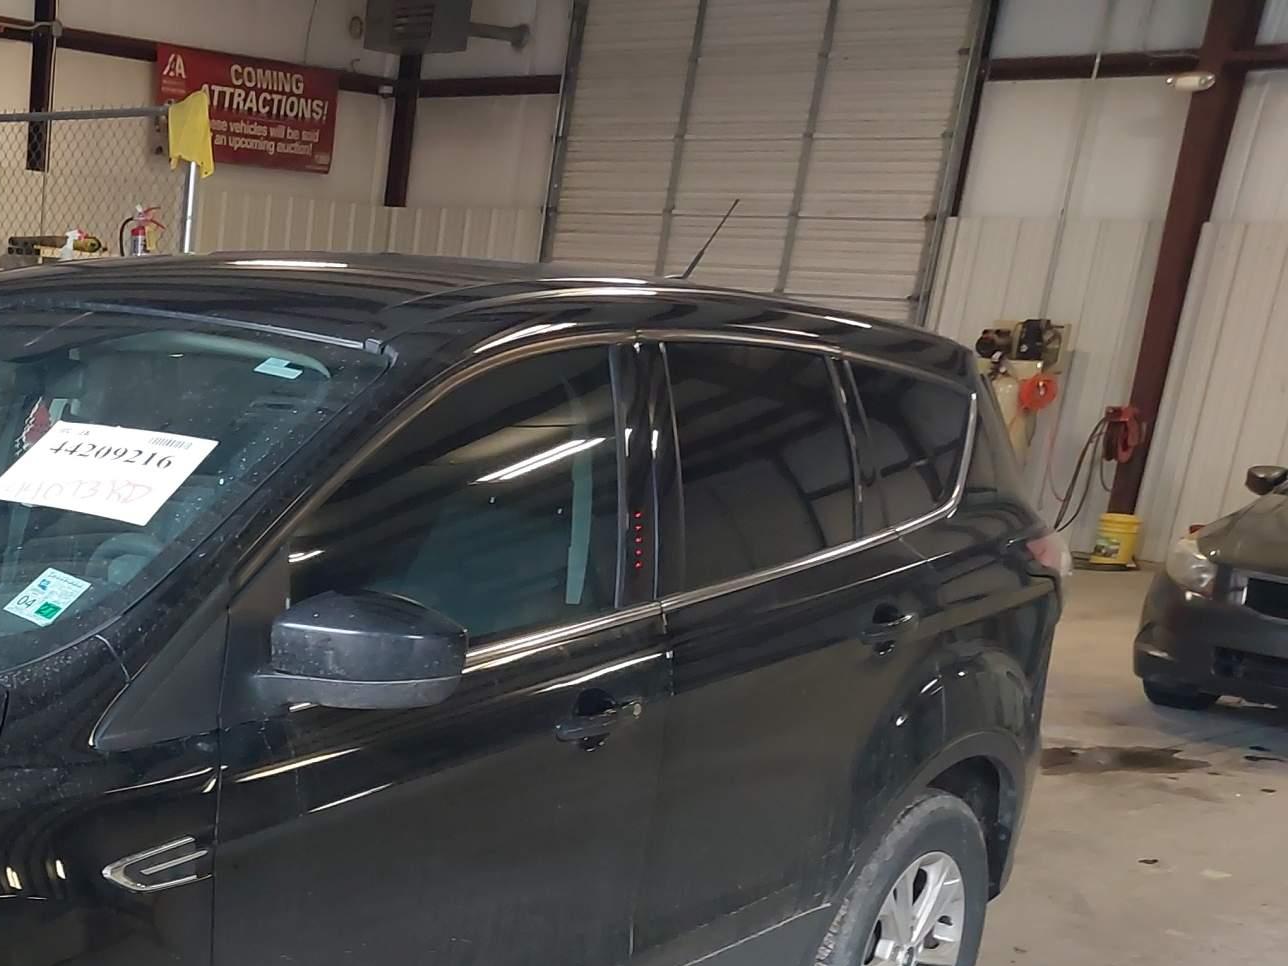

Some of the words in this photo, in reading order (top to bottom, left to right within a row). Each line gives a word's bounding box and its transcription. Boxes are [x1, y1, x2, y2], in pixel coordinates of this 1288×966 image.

[230, 64, 304, 94] COMING
[229, 120, 268, 136] vehicles
[269, 125, 285, 138] will
[286, 127, 300, 140] be
[214, 134, 227, 145] an
[228, 136, 275, 155] upcoming
[276, 140, 313, 156] auction!
[50, 440, 176, 470] 44209216
[16, 595, 37, 608] 04
